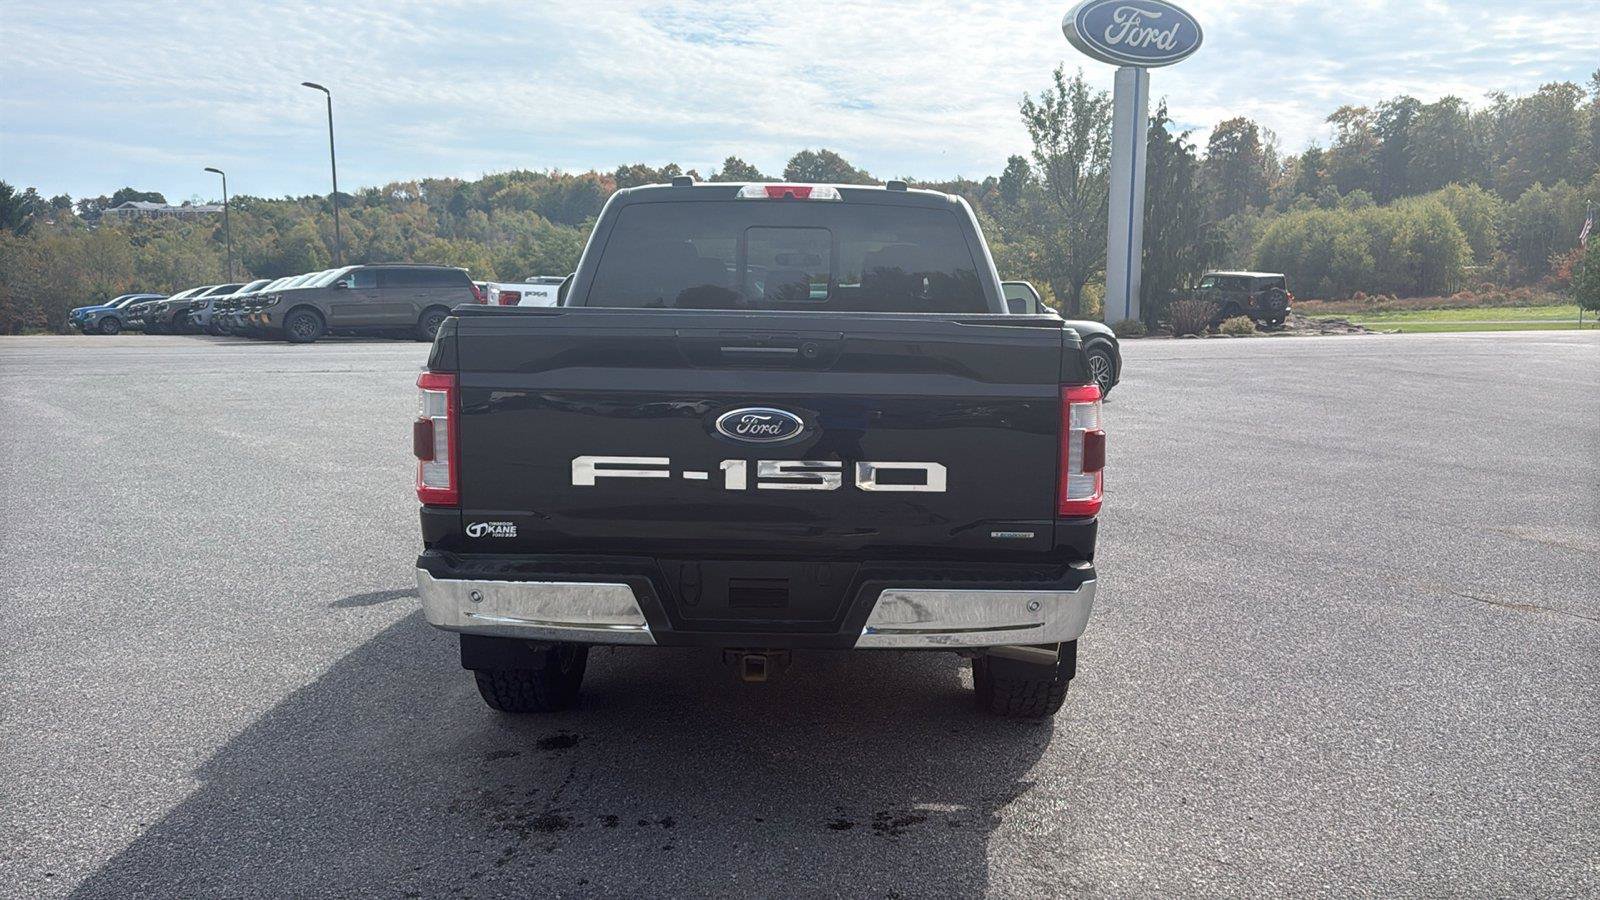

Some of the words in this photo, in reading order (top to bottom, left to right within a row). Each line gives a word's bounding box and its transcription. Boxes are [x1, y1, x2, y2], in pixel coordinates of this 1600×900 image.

[1104, 6, 1181, 51] Ford
[736, 414, 784, 435] Ford
[571, 455, 947, 492] F-150
[488, 525, 518, 533] KANE
